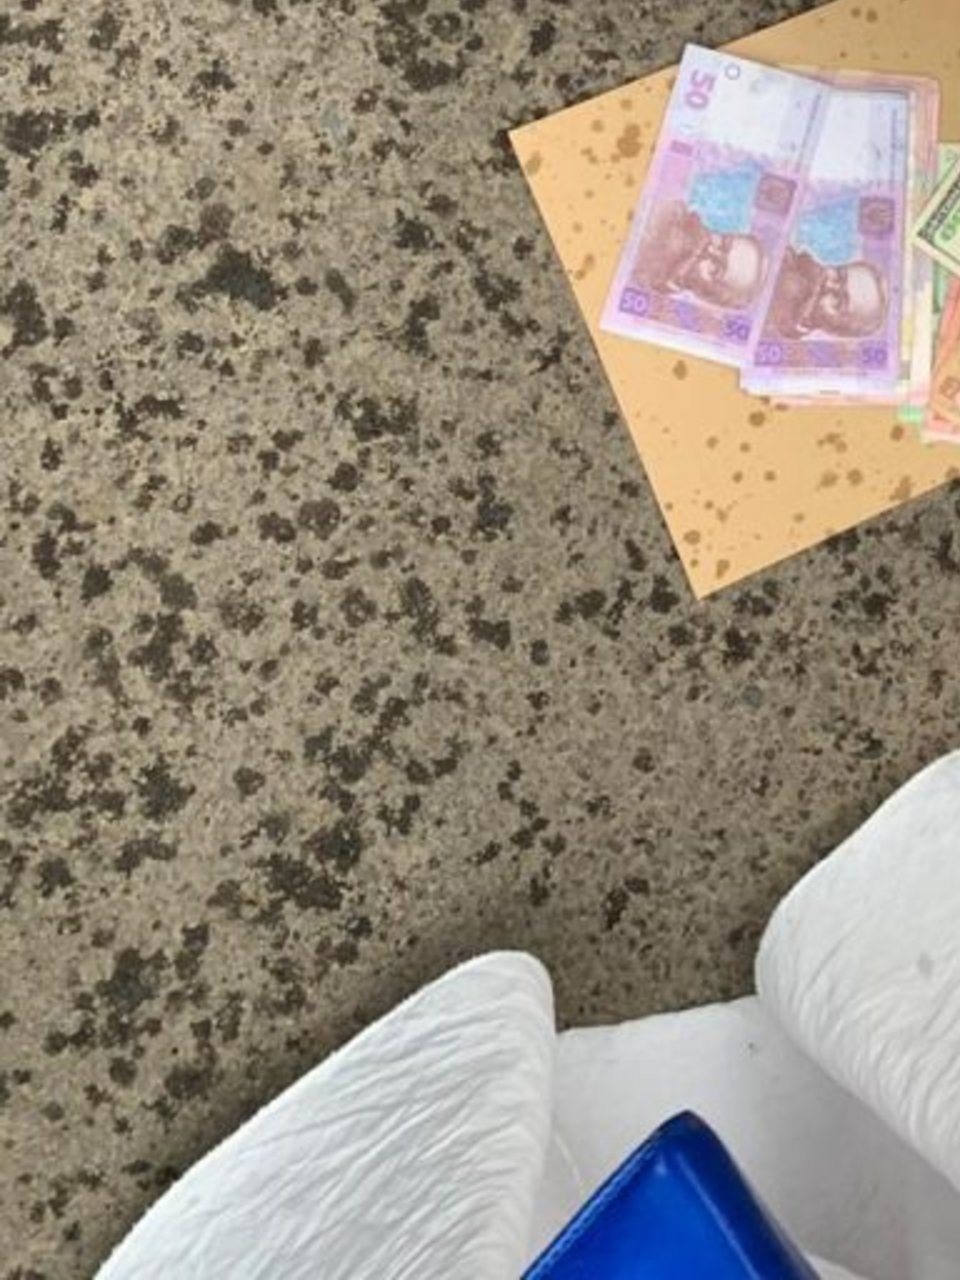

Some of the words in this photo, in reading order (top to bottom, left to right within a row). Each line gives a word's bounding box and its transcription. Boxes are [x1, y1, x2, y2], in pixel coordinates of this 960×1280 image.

[684, 69, 717, 111] 50
[621, 293, 648, 315] 50
[724, 317, 750, 341] 50
[757, 343, 782, 362] 50
[862, 345, 888, 365] 50
